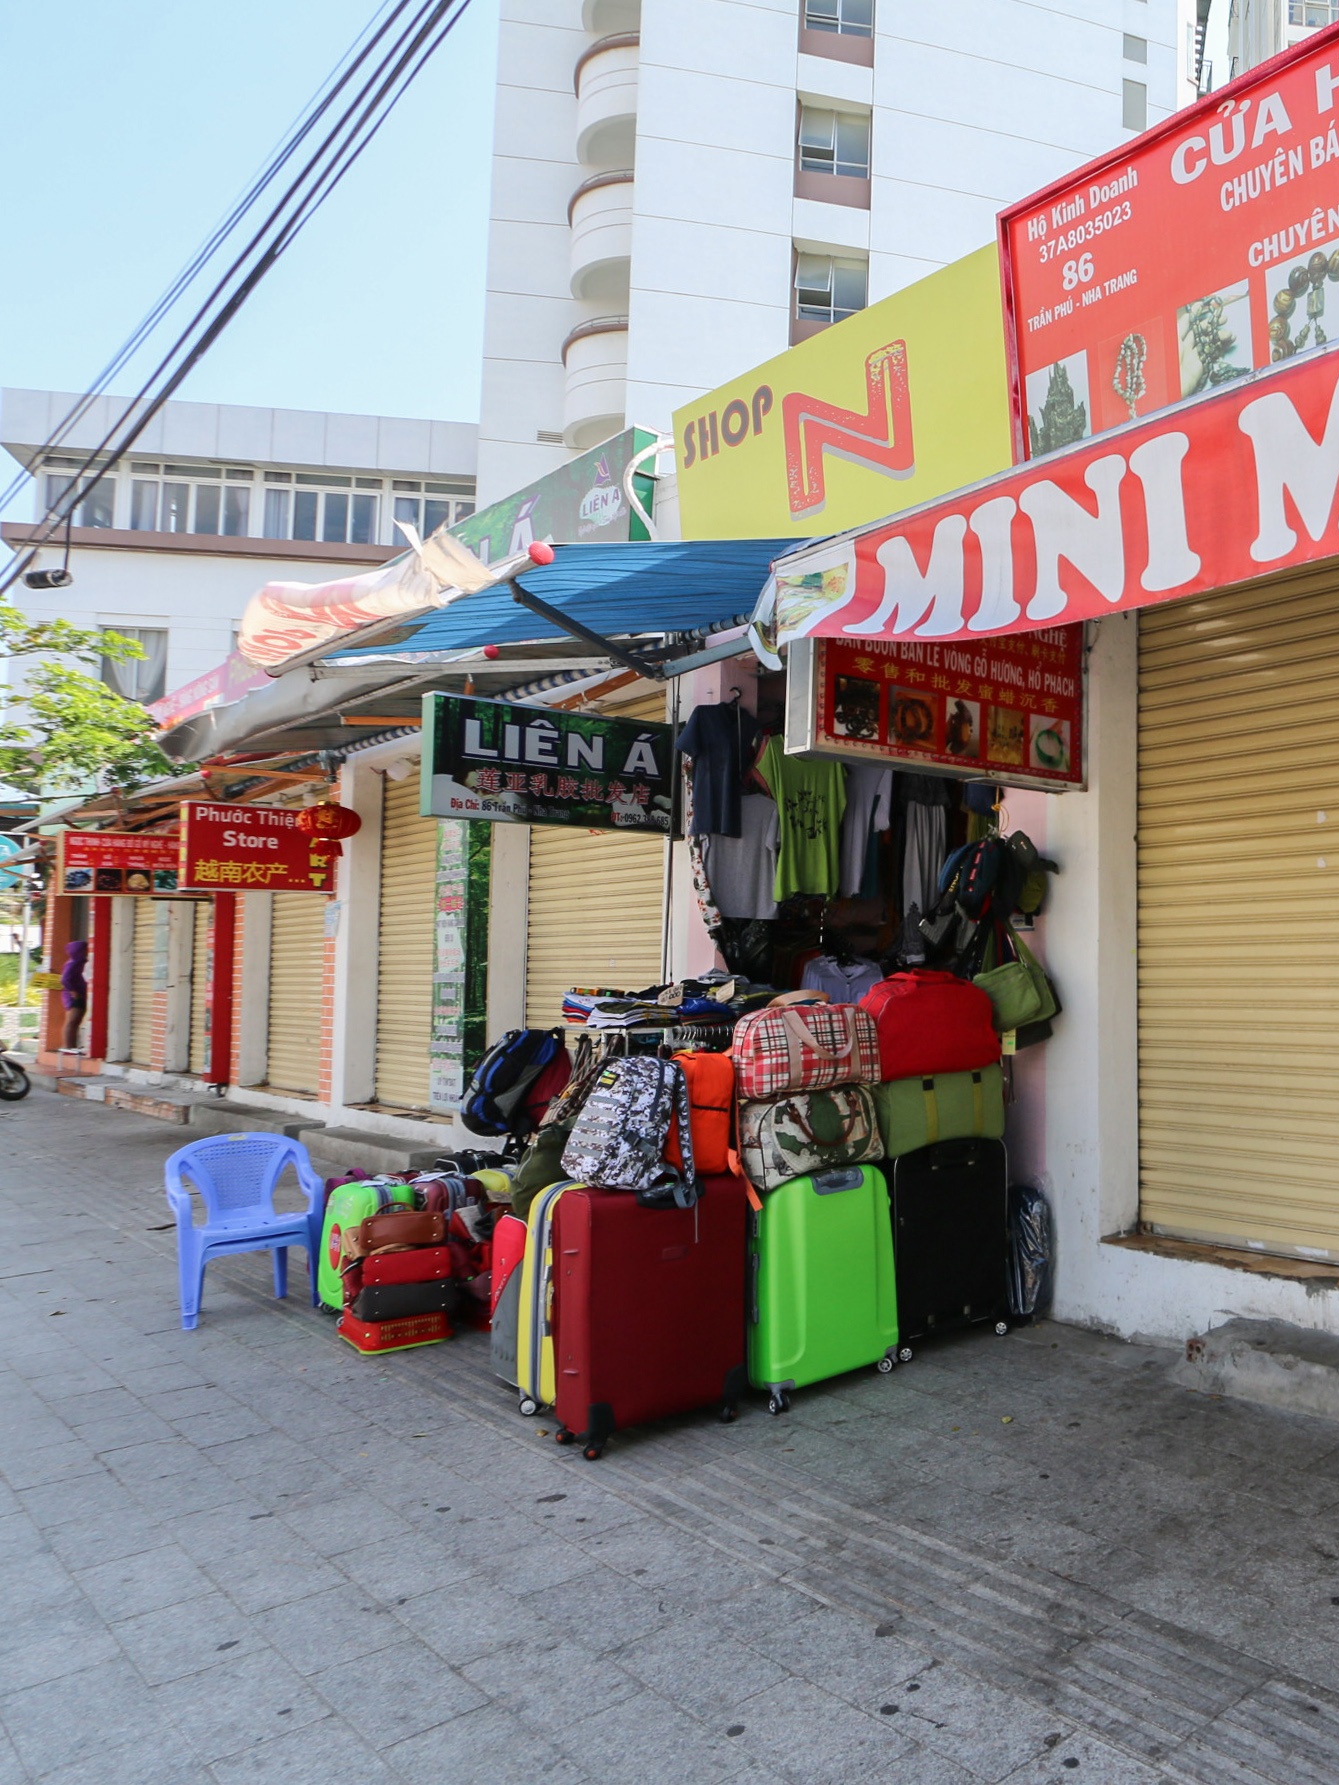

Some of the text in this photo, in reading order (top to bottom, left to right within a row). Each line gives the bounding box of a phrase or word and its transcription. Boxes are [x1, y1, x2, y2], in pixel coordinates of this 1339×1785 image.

[1170, 98, 1293, 186] CỬA
[1027, 166, 1139, 242] Hộ Kinh Doanh
[1220, 147, 1304, 211] CHUYÊN
[1039, 201, 1132, 263] 37A8035023
[1027, 306, 1053, 333] TRẦN
[1054, 295, 1074, 321] PHÚ
[1082, 285, 1102, 308] NHA
[1104, 268, 1138, 297] TRANG
[1062, 252, 1095, 291] 86
[683, 339, 915, 520] SHOP N
[582, 493, 609, 518] LIÊN
[842, 430, 1200, 637] MINI
[944, 645, 971, 674] VÒNG
[974, 648, 988, 678] GỖ
[991, 660, 1025, 690] HƯƠNG,
[1028, 661, 1042, 690] HỔ
[1044, 671, 1075, 697] PHÁCH
[463, 718, 661, 777] LIÊN Á
[195, 806, 252, 824] Phước
[476, 767, 651, 806] 莲亚乳胶批发店
[481, 800, 492, 811] 86
[223, 830, 279, 849] Store
